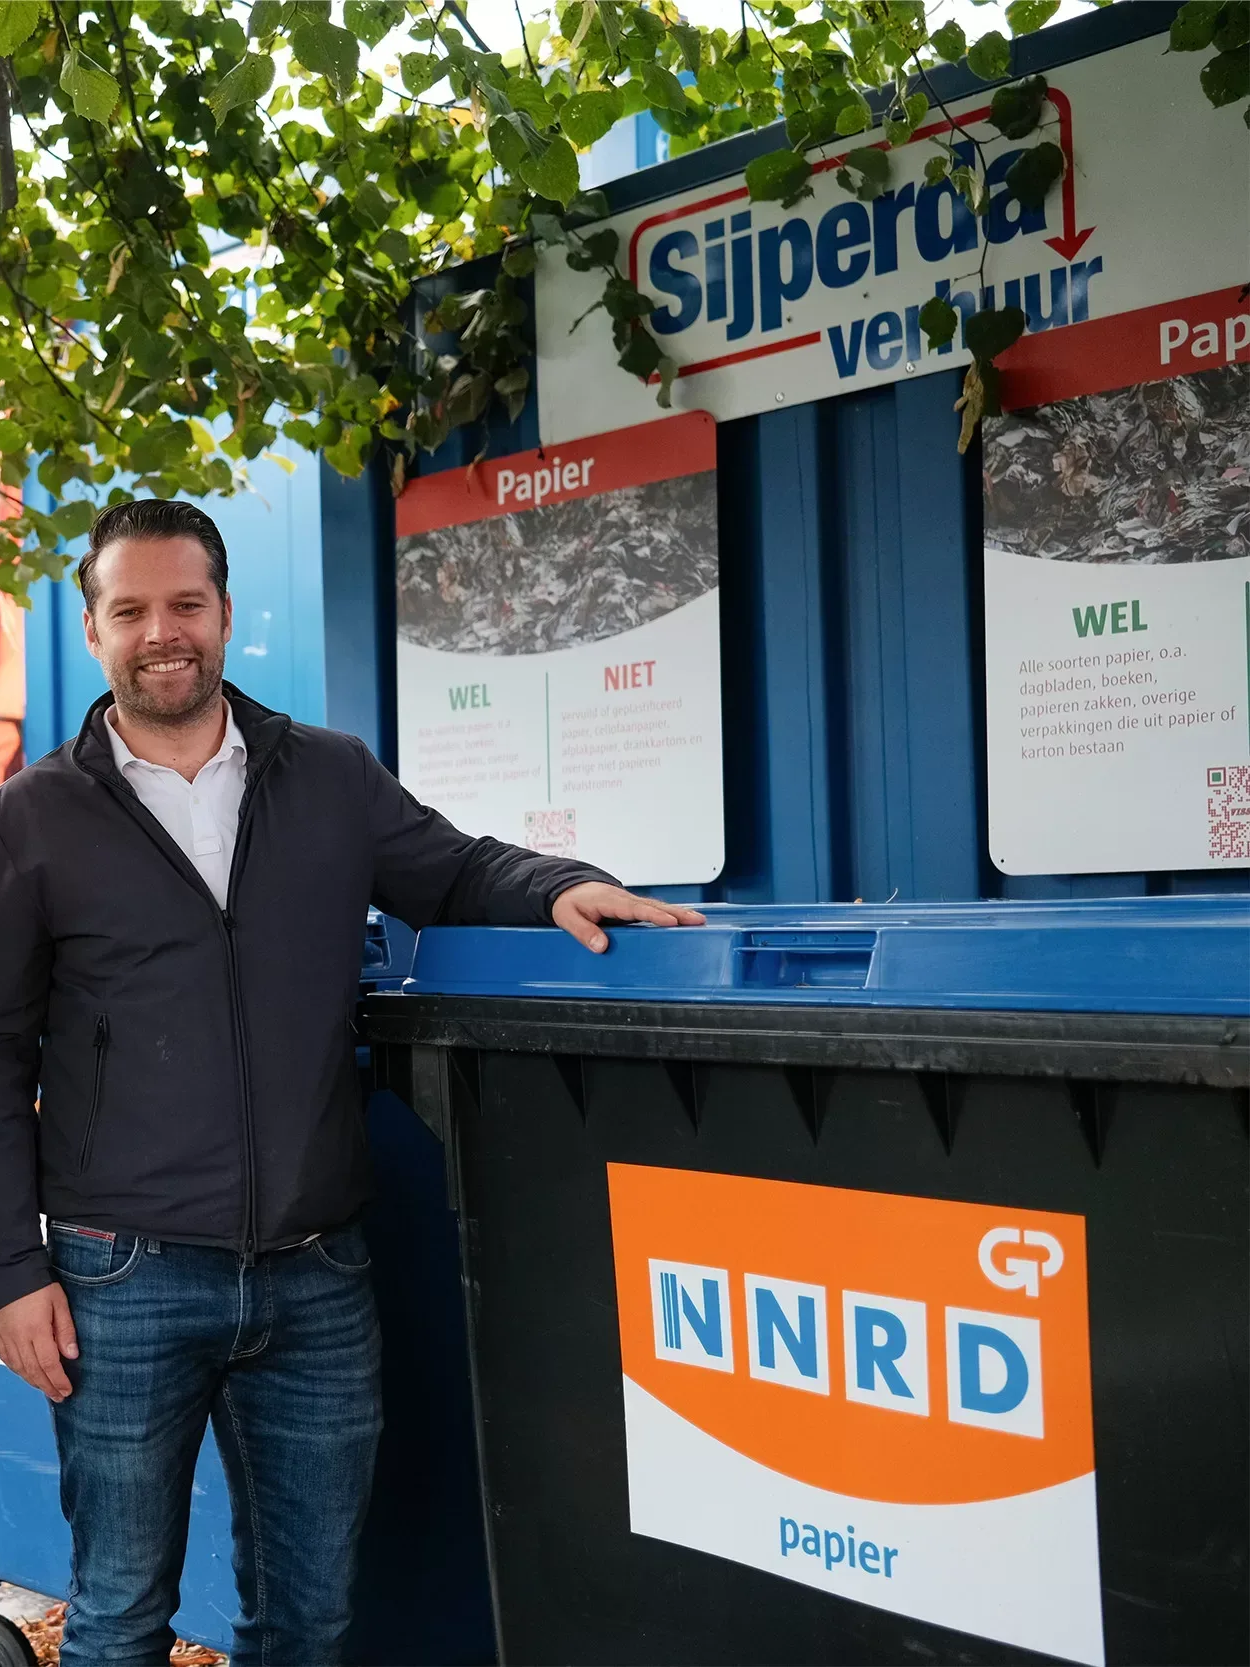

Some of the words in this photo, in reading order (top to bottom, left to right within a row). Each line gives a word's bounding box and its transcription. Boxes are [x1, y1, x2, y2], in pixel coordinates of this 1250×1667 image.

[650, 140, 1048, 342] Sijperda
[497, 457, 595, 505] Papier
[1072, 600, 1148, 638] WEL
[604, 660, 656, 692] NIET
[1019, 660, 1043, 675] Alle
[1049, 654, 1101, 671] soorten
[1105, 648, 1154, 666] papier,
[1159, 646, 1187, 658] o.a.
[449, 683, 491, 711] WEL
[1019, 677, 1096, 696] dagbladen,
[1101, 670, 1158, 688] boeken,
[600, 705, 610, 717] of
[1020, 700, 1079, 719] papieren
[1084, 695, 1136, 712] zakken,
[1142, 690, 1196, 706] overige
[1020, 717, 1112, 739] verpakkingen
[1117, 715, 1139, 730] die
[1144, 711, 1163, 727] uit
[1168, 708, 1215, 728] papier
[1220, 706, 1236, 721] of
[1021, 745, 1065, 759] karton
[1070, 740, 1124, 756] bestaan
[660, 1272, 1029, 1413] NNRD
[779, 1516, 899, 1578] papier
